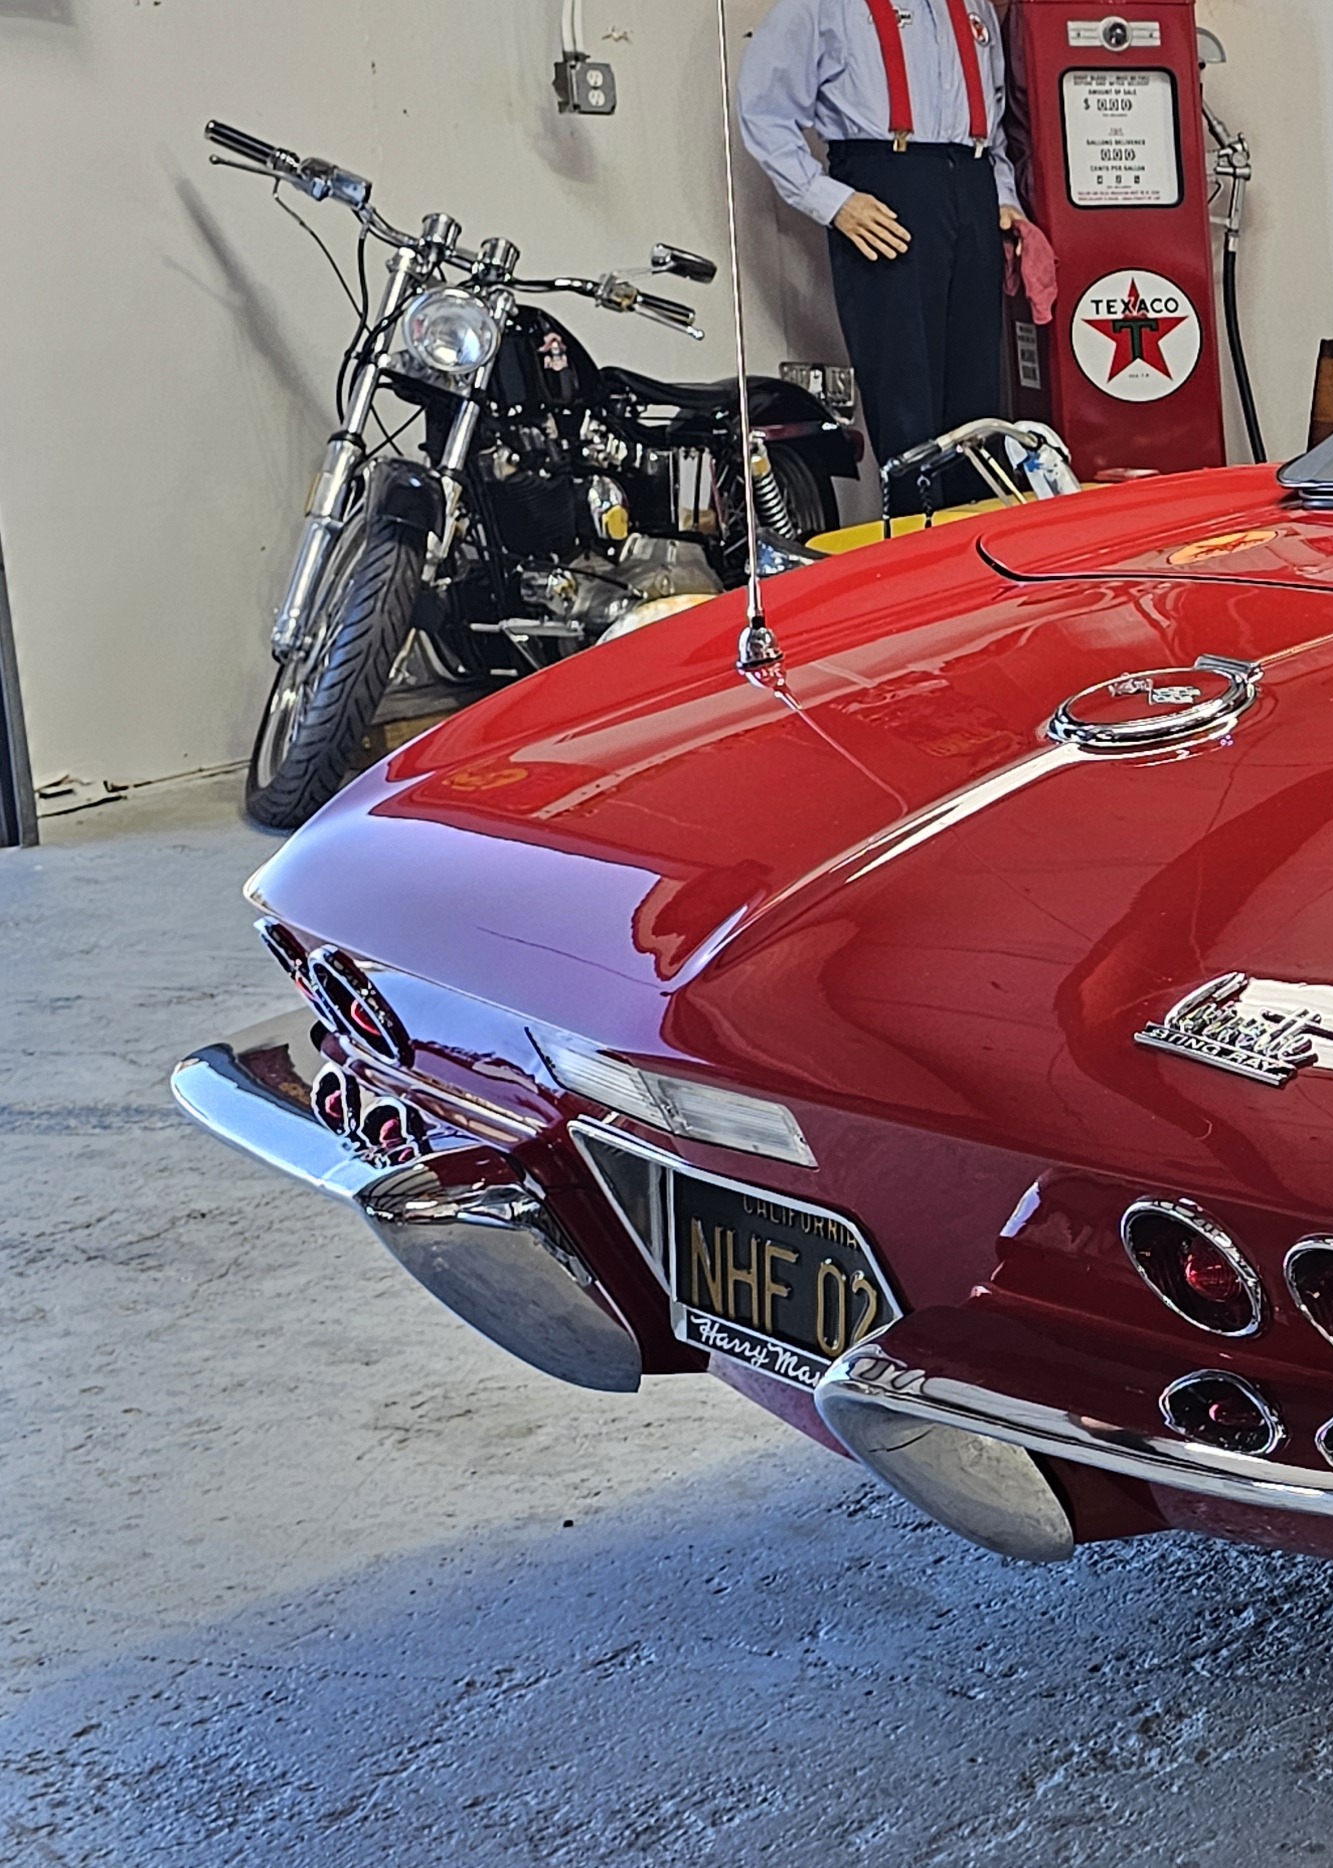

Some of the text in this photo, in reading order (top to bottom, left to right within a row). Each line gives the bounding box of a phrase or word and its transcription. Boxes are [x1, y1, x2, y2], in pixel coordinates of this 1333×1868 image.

[1090, 297, 1179, 315] TEXACO
[1150, 1028, 1280, 1072] STING RAY
[691, 1215, 800, 1334] NHF
[690, 1314, 770, 1368] Harry
